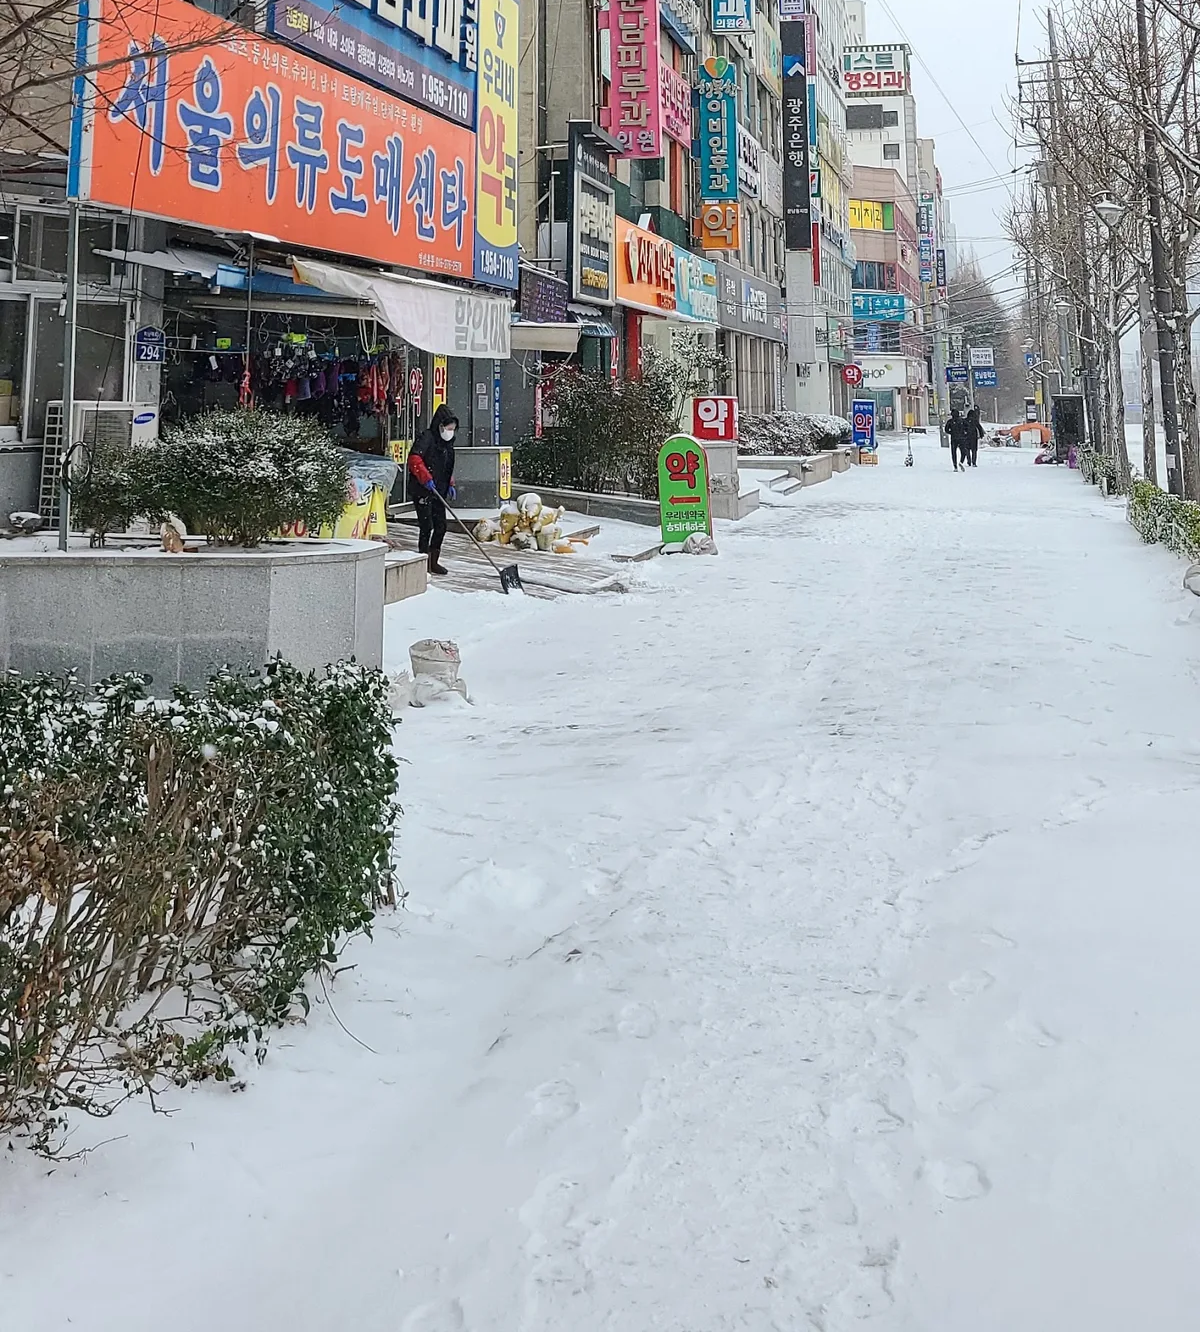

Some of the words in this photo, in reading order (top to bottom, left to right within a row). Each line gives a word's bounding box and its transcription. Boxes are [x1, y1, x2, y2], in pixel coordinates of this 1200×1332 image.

[716, 19, 735, 28] 의원
[327, 25, 338, 51] 내과
[340, 34, 355, 60] 소아과
[358, 43, 376, 68] 정형외과
[378, 52, 396, 80] 신경외과
[421, 73, 468, 118] T.955-7119
[484, 48, 514, 109] 우리네
[112, 38, 468, 249] 서울의류도매센타
[617, 130, 655, 153] 의원
[707, 99, 730, 193] 이비인후과
[787, 98, 804, 167] 광주은행
[704, 207, 736, 244] 약
[480, 250, 514, 281] T.954-7119
[140, 346, 160, 360] 294
[434, 367, 446, 401] 약
[846, 368, 858, 381] 약
[698, 399, 728, 436] 약
[854, 412, 872, 438] 약
[666, 450, 699, 489] 약
[665, 510, 705, 519] 우리네약국
